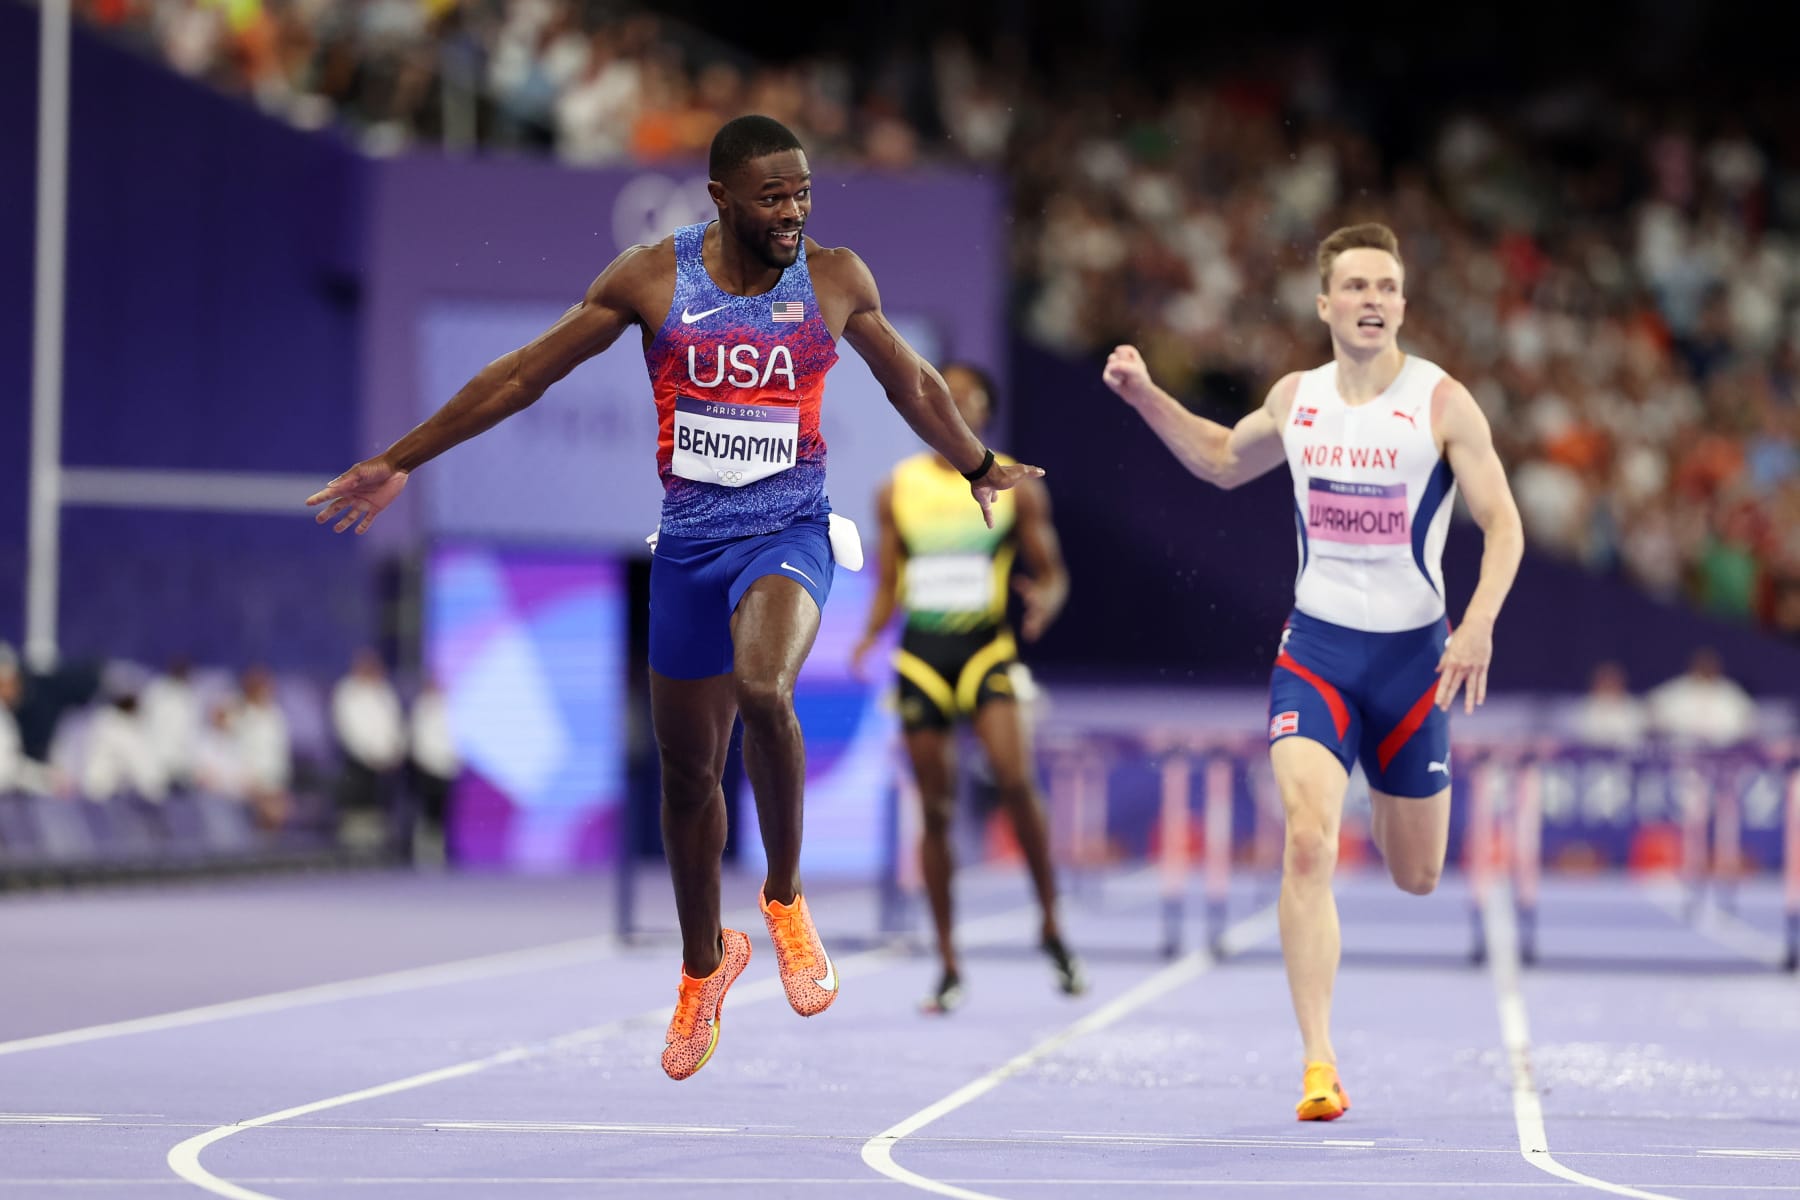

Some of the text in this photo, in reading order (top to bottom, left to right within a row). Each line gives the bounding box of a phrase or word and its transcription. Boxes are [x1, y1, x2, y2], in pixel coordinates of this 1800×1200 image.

[688, 344, 795, 390] USA
[706, 405, 767, 417] PARIS 2024
[678, 425, 793, 463] BENJAMIN
[1302, 446, 1398, 469] NORWAY
[1309, 505, 1405, 534] WARHOLM
